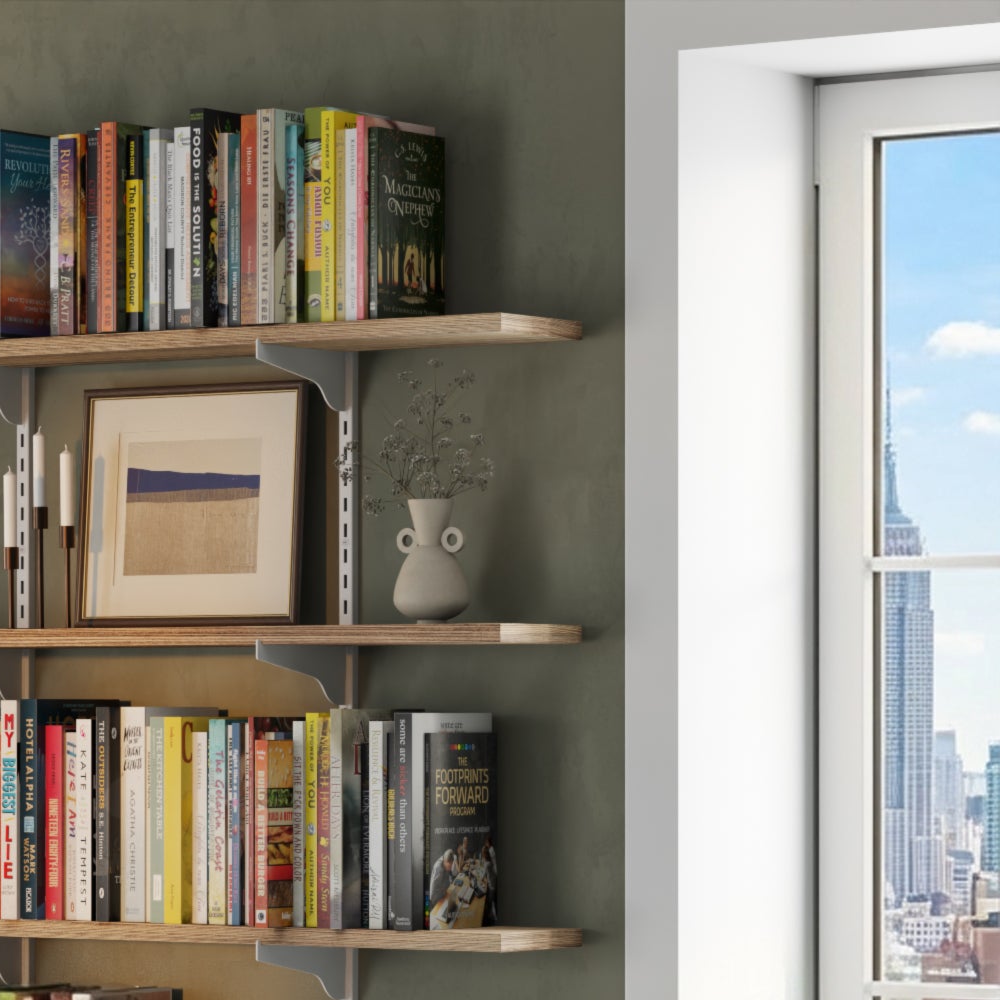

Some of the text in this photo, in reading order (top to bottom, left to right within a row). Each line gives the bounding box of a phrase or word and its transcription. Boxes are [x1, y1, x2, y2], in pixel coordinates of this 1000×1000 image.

[193, 173, 200, 181] IS
[382, 175, 441, 202] MAGICIAN'S
[406, 170, 417, 182] THE
[286, 157, 295, 277] SEASONS CHANGE
[387, 197, 435, 228] NEPHEW
[60, 288, 69, 324] PRATT
[25, 719, 34, 811] HOTEL ALPHA
[66, 742, 77, 792] Here
[435, 768, 489, 784] FOOTPRINTS
[458, 757, 468, 766] THE
[2, 758, 16, 816] BIGGEST
[435, 786, 489, 805] FORWARD
[66, 808, 77, 838] Am
[214, 751, 224, 872] The Gelatin Coast
[450, 806, 476, 816] PROGRAM
[4, 825, 13, 879] LIE
[49, 798, 58, 887] NINETEEN EIGHTY-FOUR
[320, 853, 329, 884] Sandy
